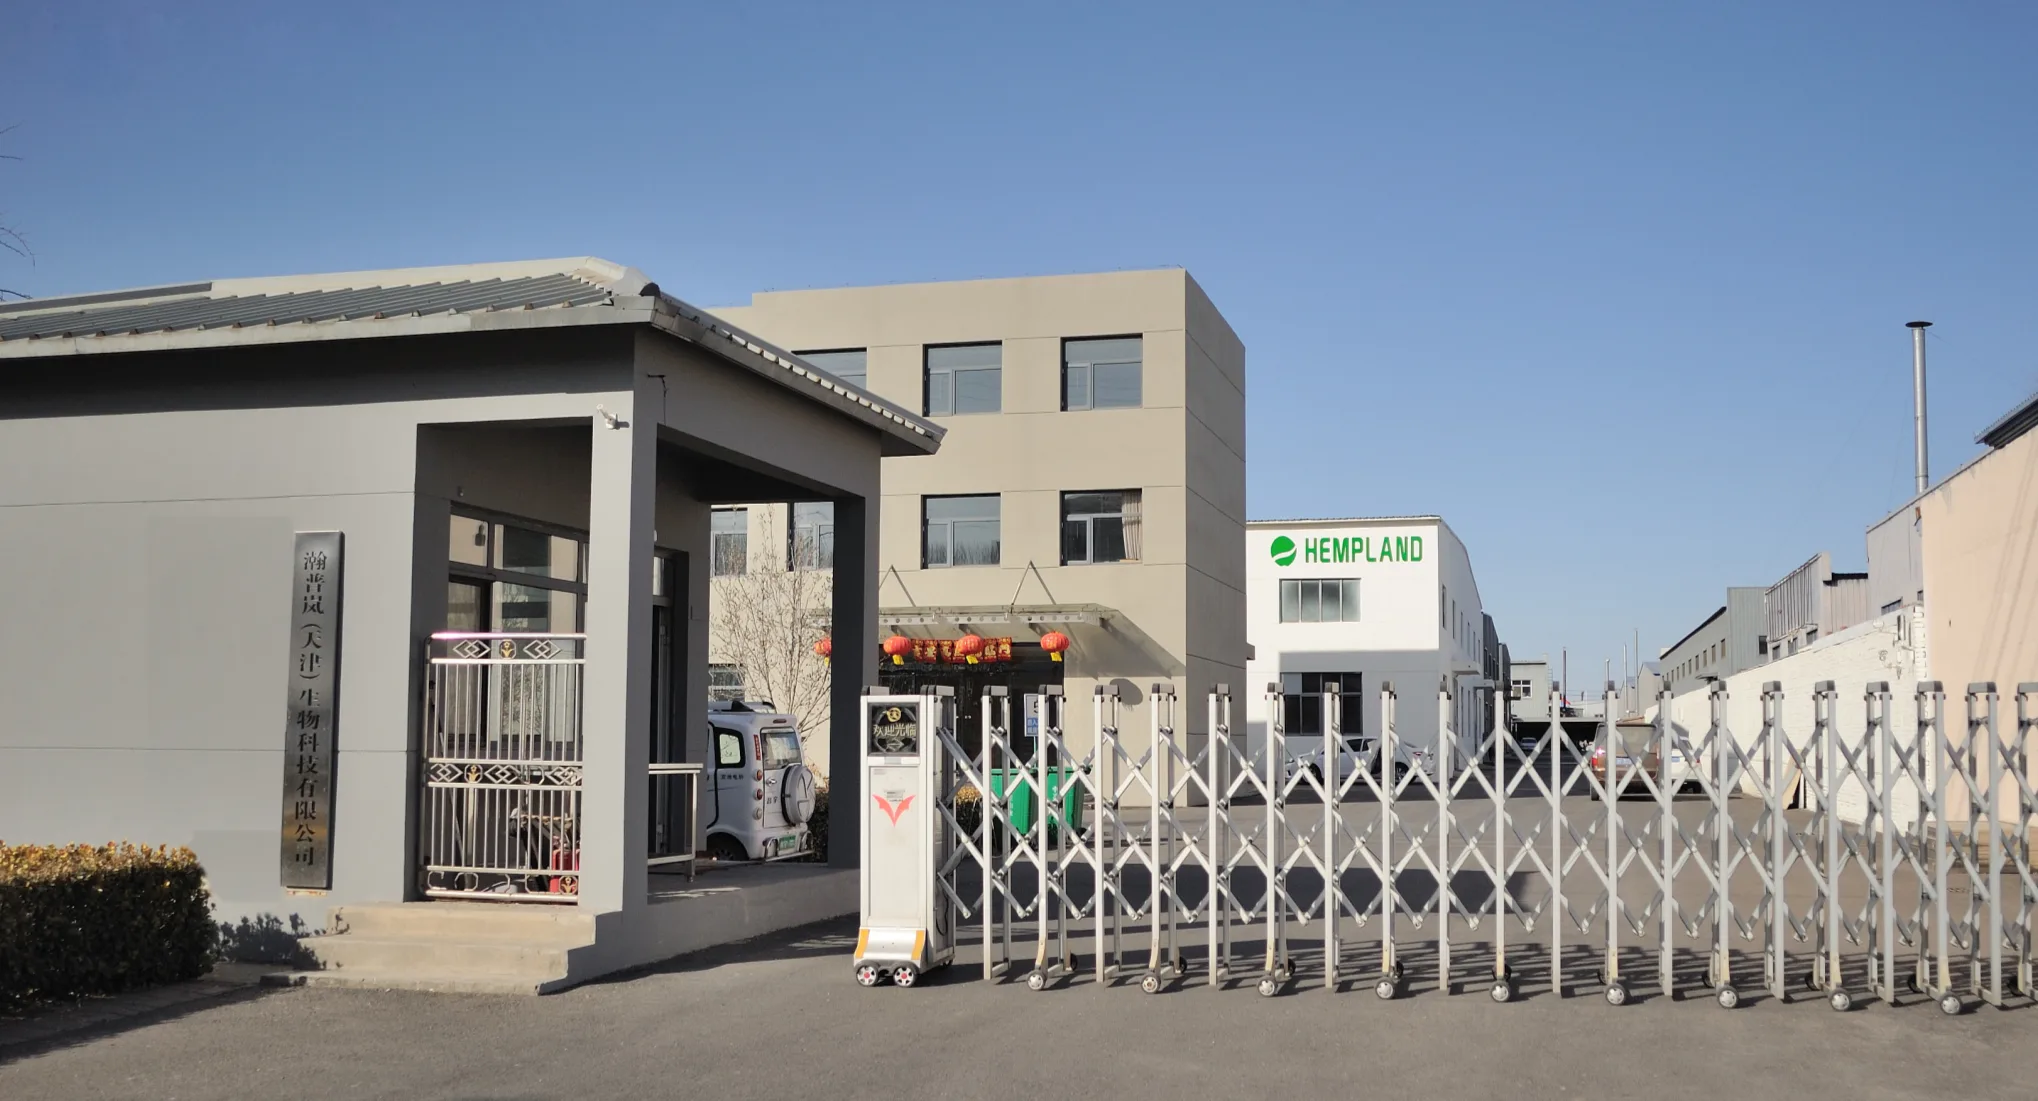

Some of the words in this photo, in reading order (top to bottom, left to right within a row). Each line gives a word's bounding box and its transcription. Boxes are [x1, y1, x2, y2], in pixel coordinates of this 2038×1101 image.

[1305, 535, 1423, 564] HEMPLAND
[872, 722, 917, 738] 欢迎光临
